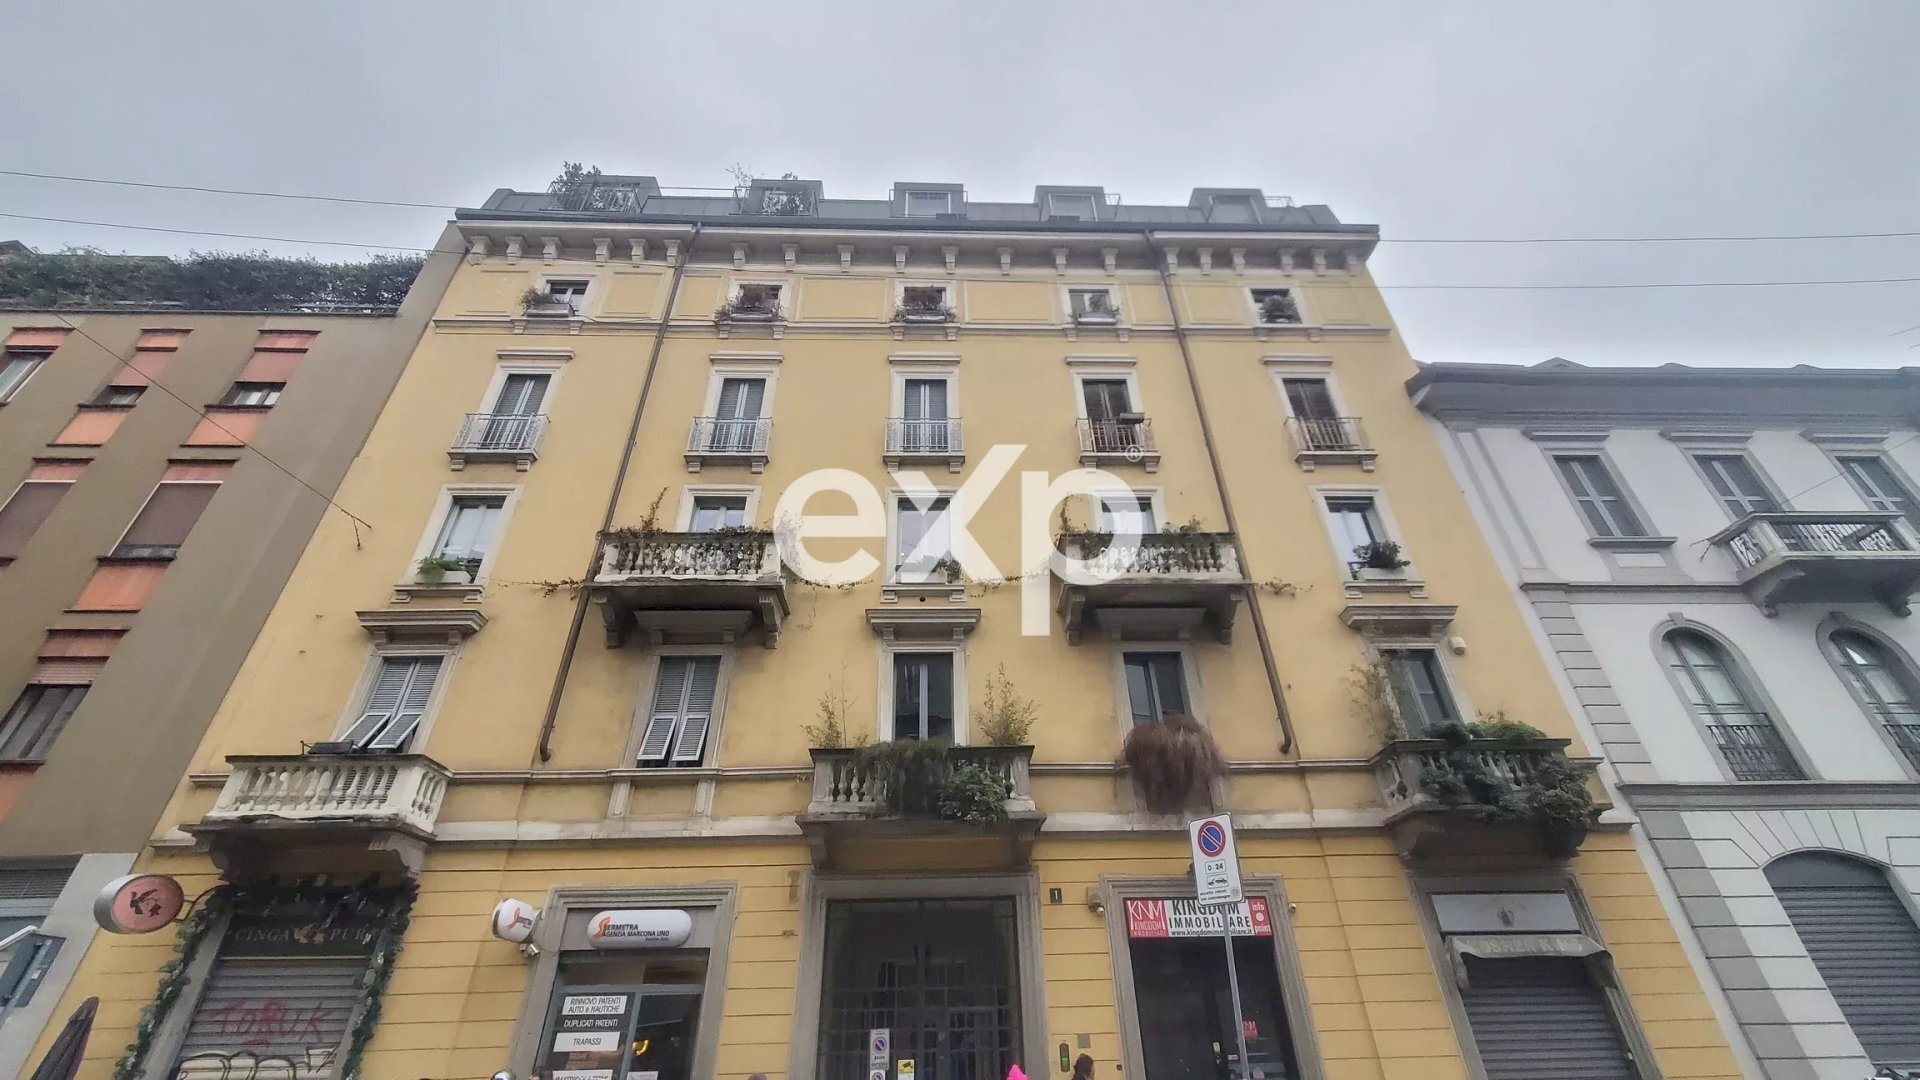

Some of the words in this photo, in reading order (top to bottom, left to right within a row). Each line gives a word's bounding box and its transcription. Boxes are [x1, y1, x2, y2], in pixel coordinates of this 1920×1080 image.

[1172, 900, 1240, 916] KINGDM
[1251, 903, 1265, 911] info
[1127, 900, 1166, 931] KNM
[1133, 921, 1163, 930] KINGDOM
[1168, 916, 1251, 929] IMMOBILARE
[1171, 929, 1253, 937] www.kingdomimmbiliare.it
[1254, 924, 1272, 934] point
[570, 997, 597, 1005] RINNOVO
[597, 997, 621, 1005] PATENTI
[590, 1005, 620, 1013] NAUTICHE
[563, 1019, 594, 1028] DUPLICATI
[594, 1019, 619, 1028] PATENTI
[573, 1038, 602, 1046] TRAPASSI
